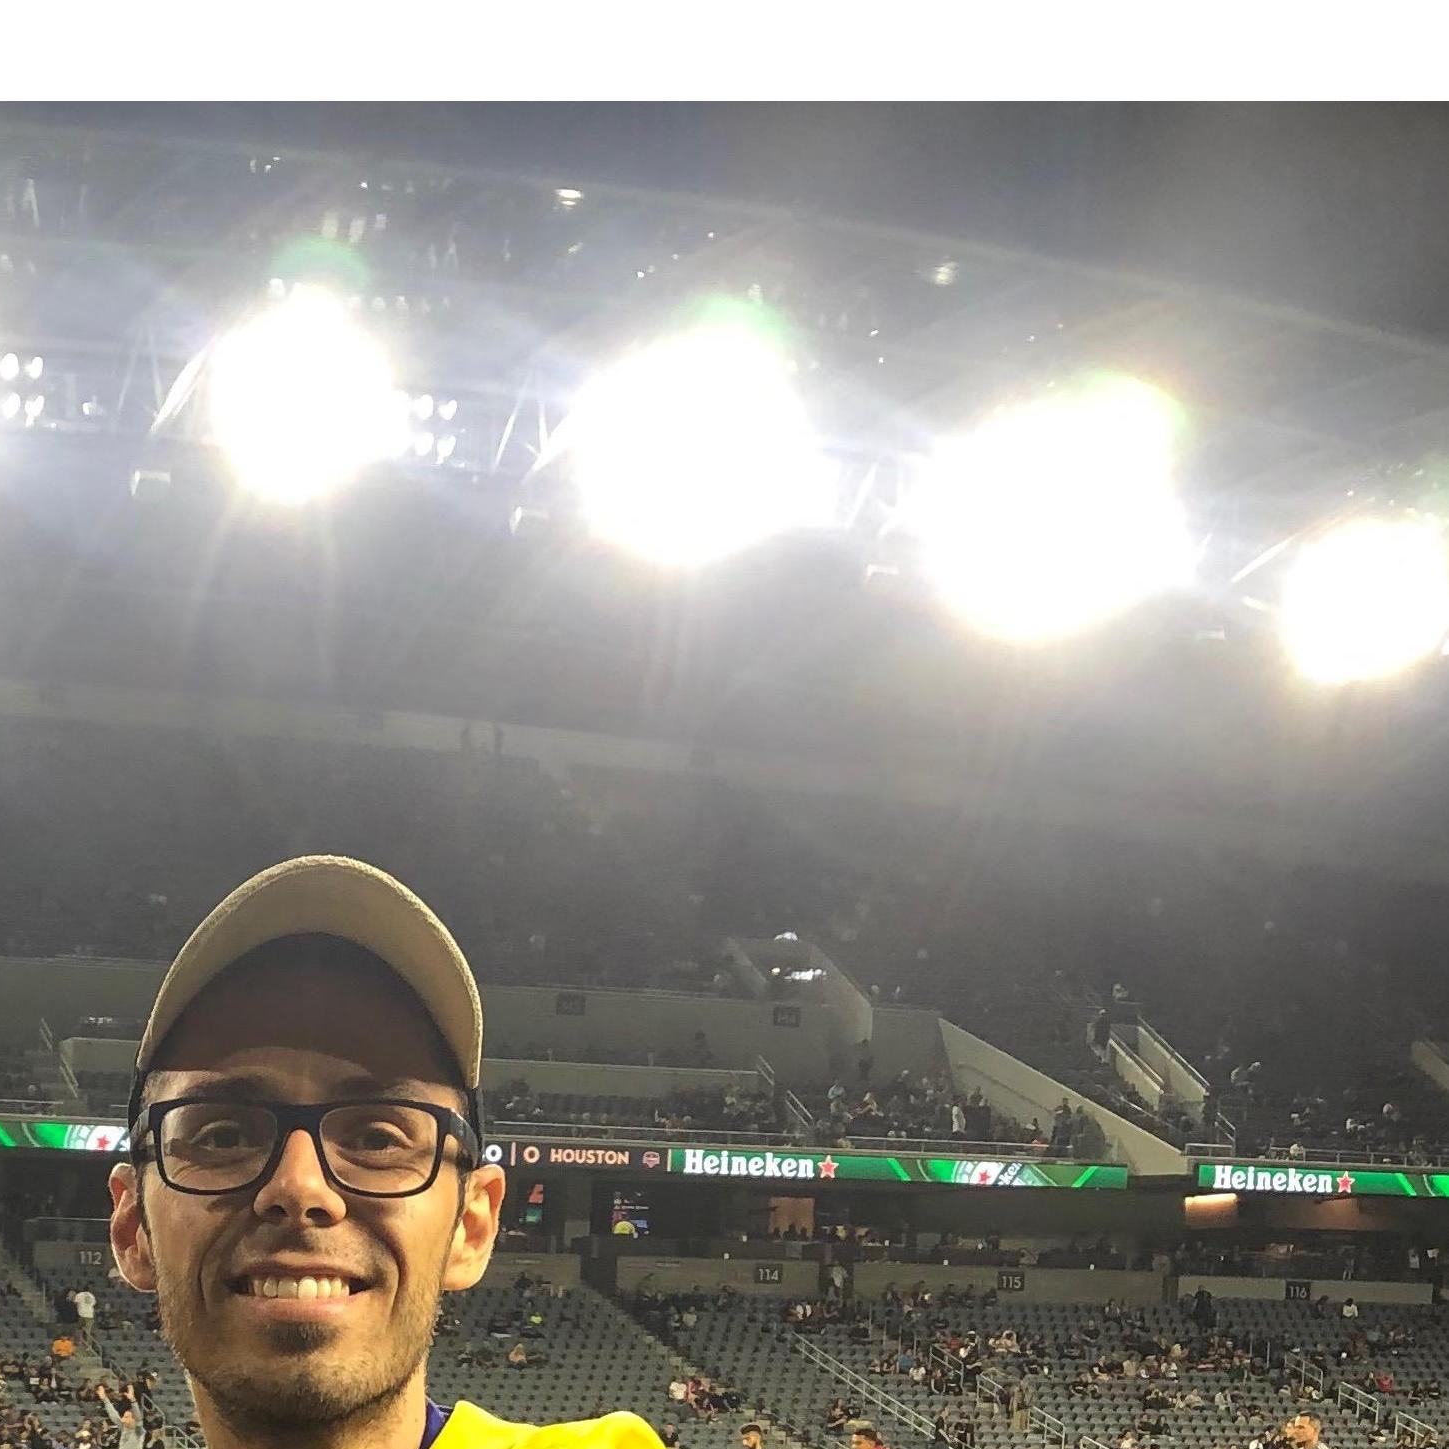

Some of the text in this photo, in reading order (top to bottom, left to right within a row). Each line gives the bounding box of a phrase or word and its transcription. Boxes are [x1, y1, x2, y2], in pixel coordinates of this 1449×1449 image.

[550, 1148, 630, 1165] HOUSTON
[683, 1149, 815, 1178] Heineken
[1212, 1165, 1333, 1193] Heineken
[79, 1251, 102, 1265] 112
[759, 1268, 779, 1281] 114
[1001, 1275, 1022, 1289] 115
[1288, 1285, 1308, 1299] 116
